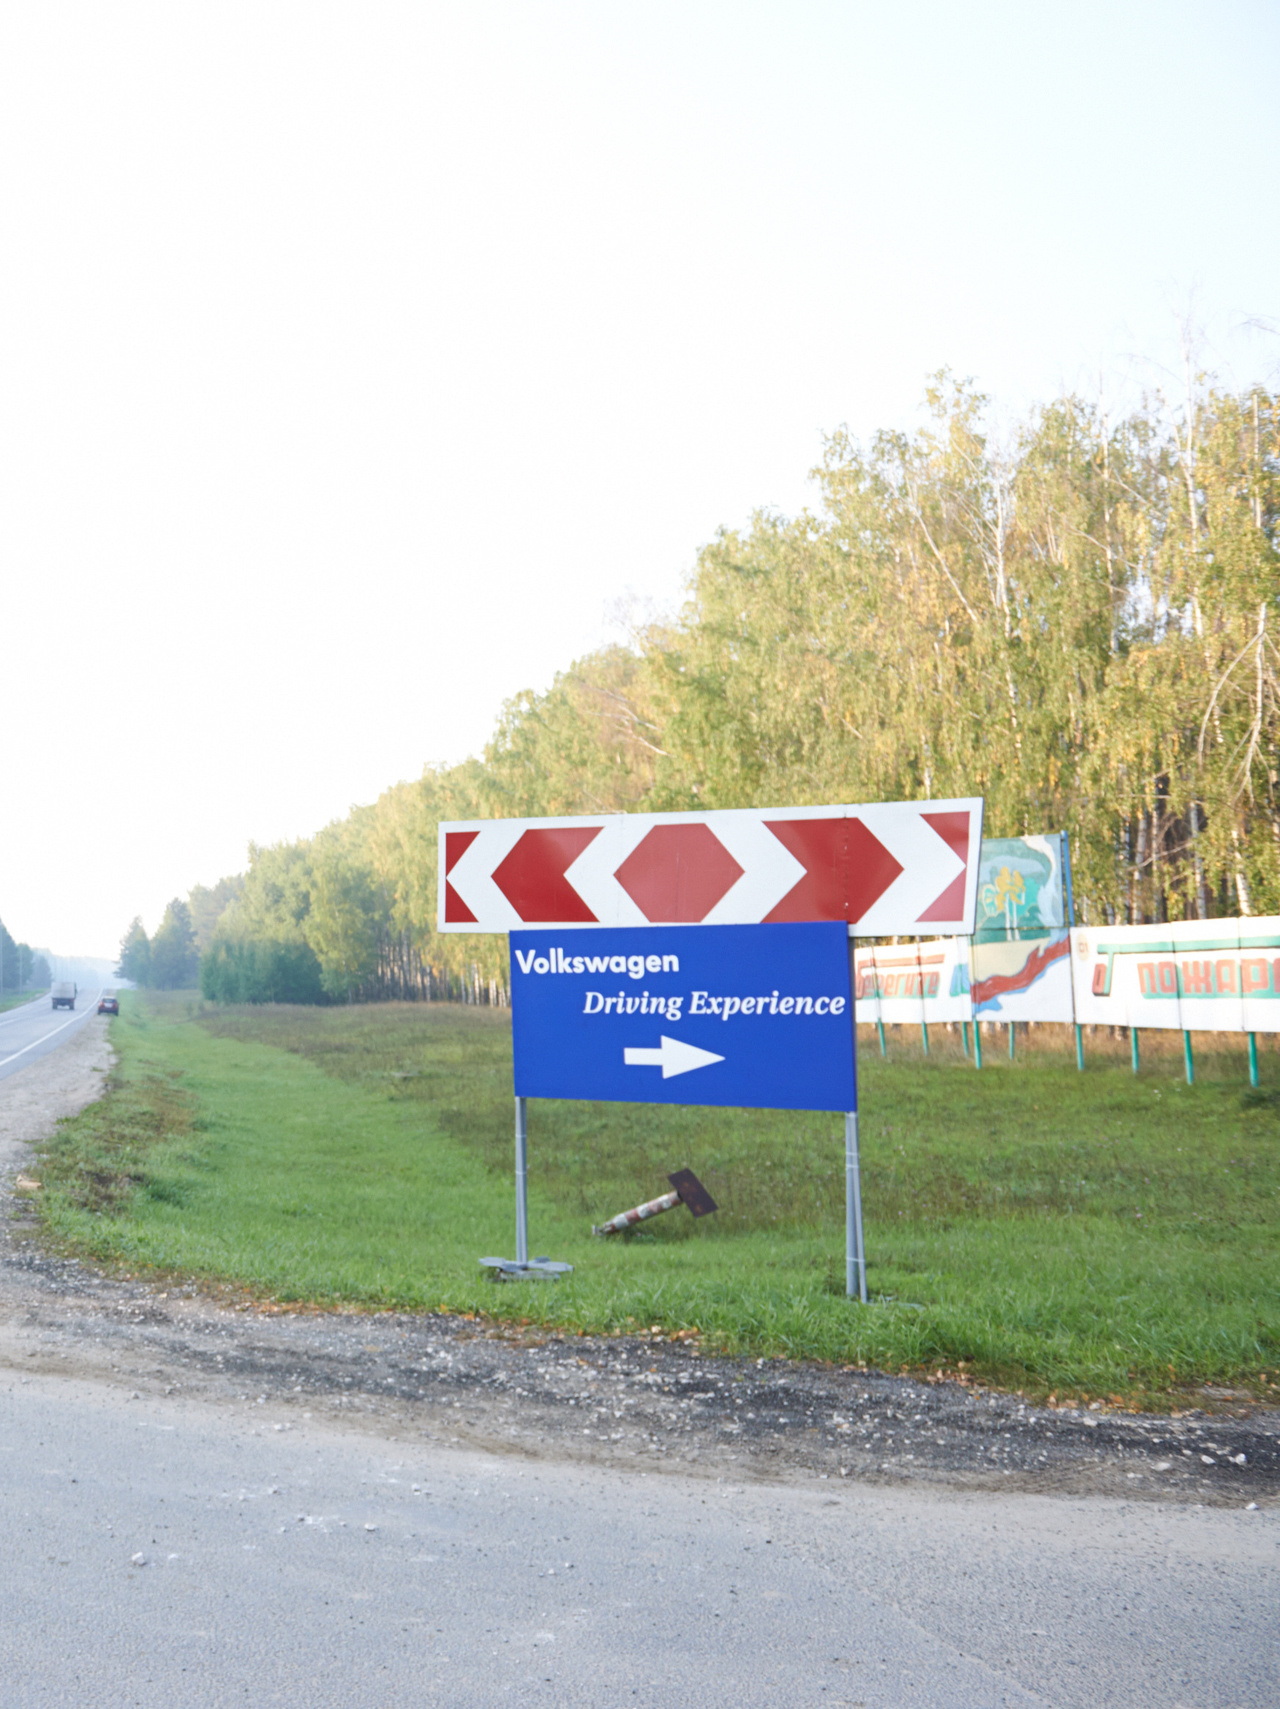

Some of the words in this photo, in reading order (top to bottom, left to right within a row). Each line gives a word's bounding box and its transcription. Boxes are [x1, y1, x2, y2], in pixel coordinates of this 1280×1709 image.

[515, 948, 680, 979] Volkswagen
[583, 991, 683, 1021] Driving
[688, 990, 846, 1021] Experience
